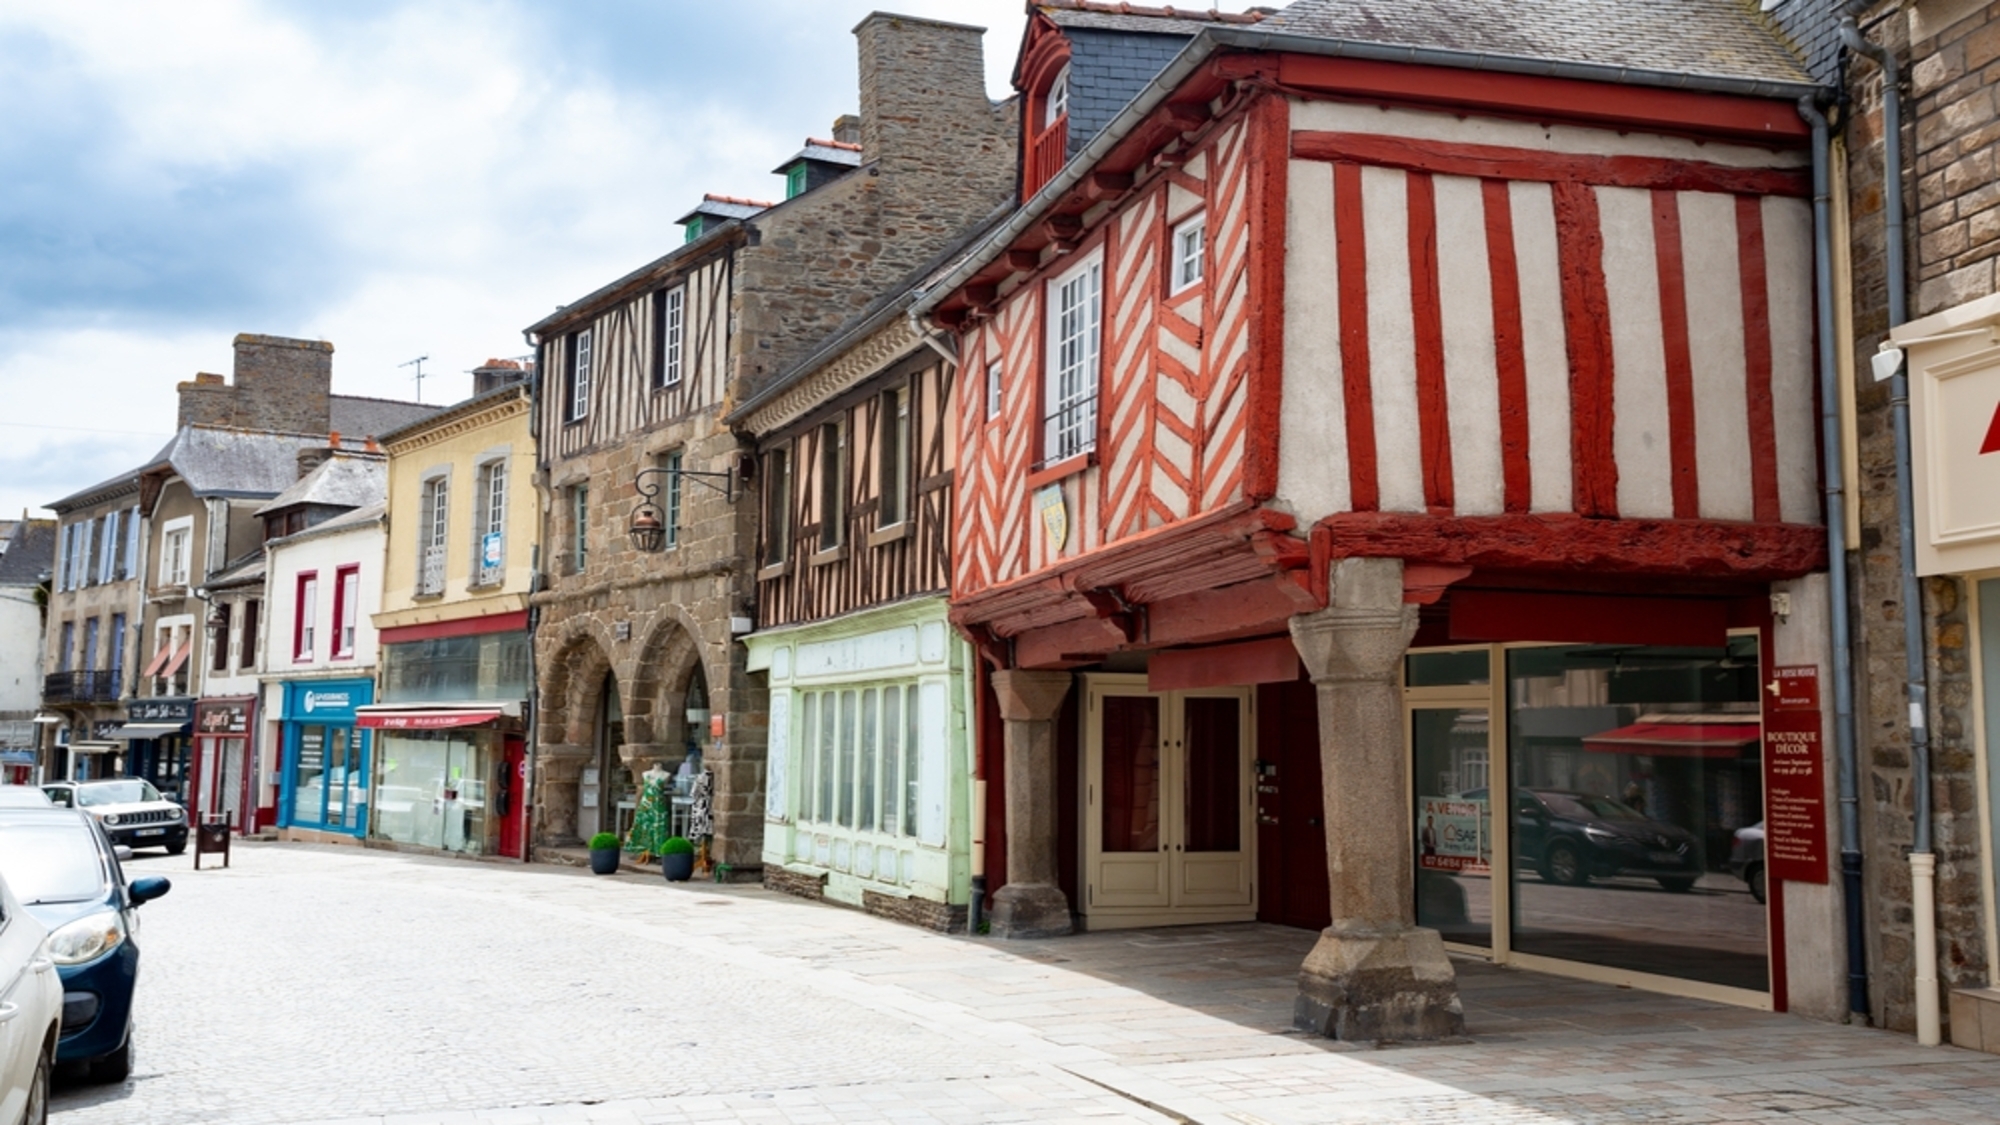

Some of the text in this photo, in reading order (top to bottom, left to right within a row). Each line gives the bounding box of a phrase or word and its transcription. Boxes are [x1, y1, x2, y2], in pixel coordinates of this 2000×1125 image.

[1767, 731, 1817, 744] BOUTIQUE
[1776, 742, 1809, 754] DÉCOR
[1437, 802, 1480, 816] VENDR
